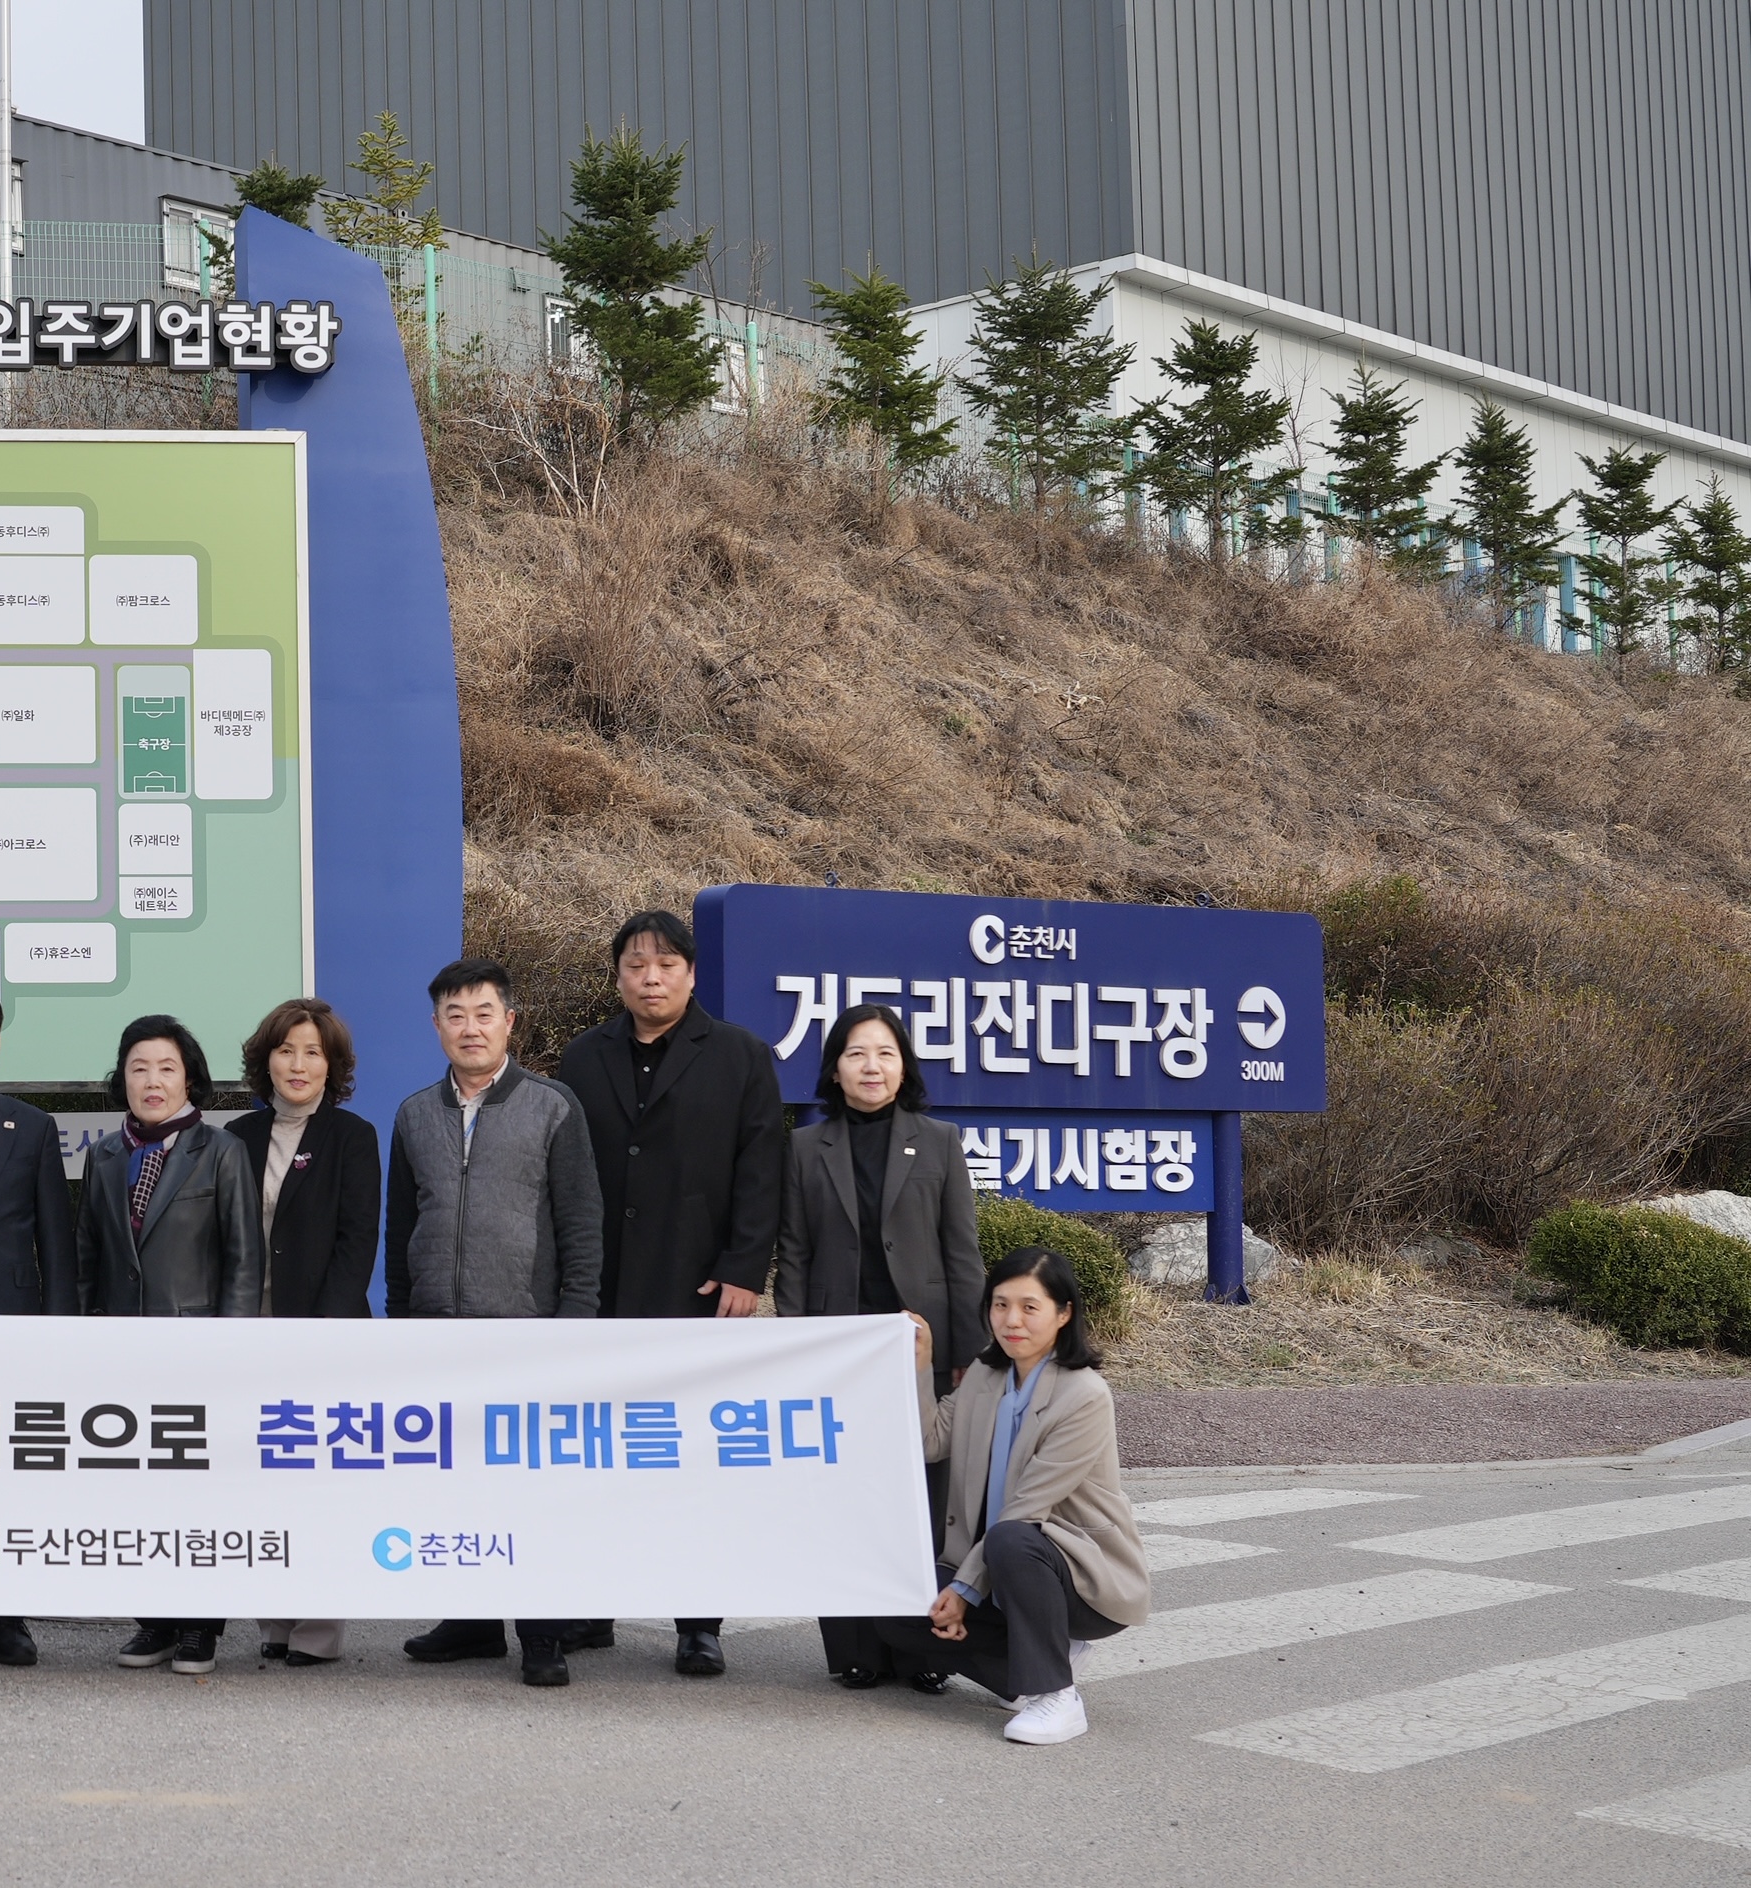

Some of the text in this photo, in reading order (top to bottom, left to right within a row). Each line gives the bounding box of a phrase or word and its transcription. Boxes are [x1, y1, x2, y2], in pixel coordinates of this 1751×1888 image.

[115, 595, 171, 607] ㈜팜크로스
[1, 709, 35, 722] ㈜일화
[200, 709, 266, 722] 바디텍메드㈜
[213, 724, 253, 737] 제3공장
[137, 737, 171, 751] 축구장
[129, 833, 180, 848] (주)래디안
[133, 887, 178, 899] ㈜에이스
[134, 900, 178, 912] 네트웍스
[1008, 924, 1077, 960] 춘천시
[29, 946, 92, 961] (주)휴온스엔
[1240, 1060, 1285, 1082] 300M
[256, 1399, 453, 1470] 춘천의
[484, 1401, 683, 1470] 미래를
[709, 1396, 844, 1468] 열다
[417, 1532, 515, 1567] 춘천시
